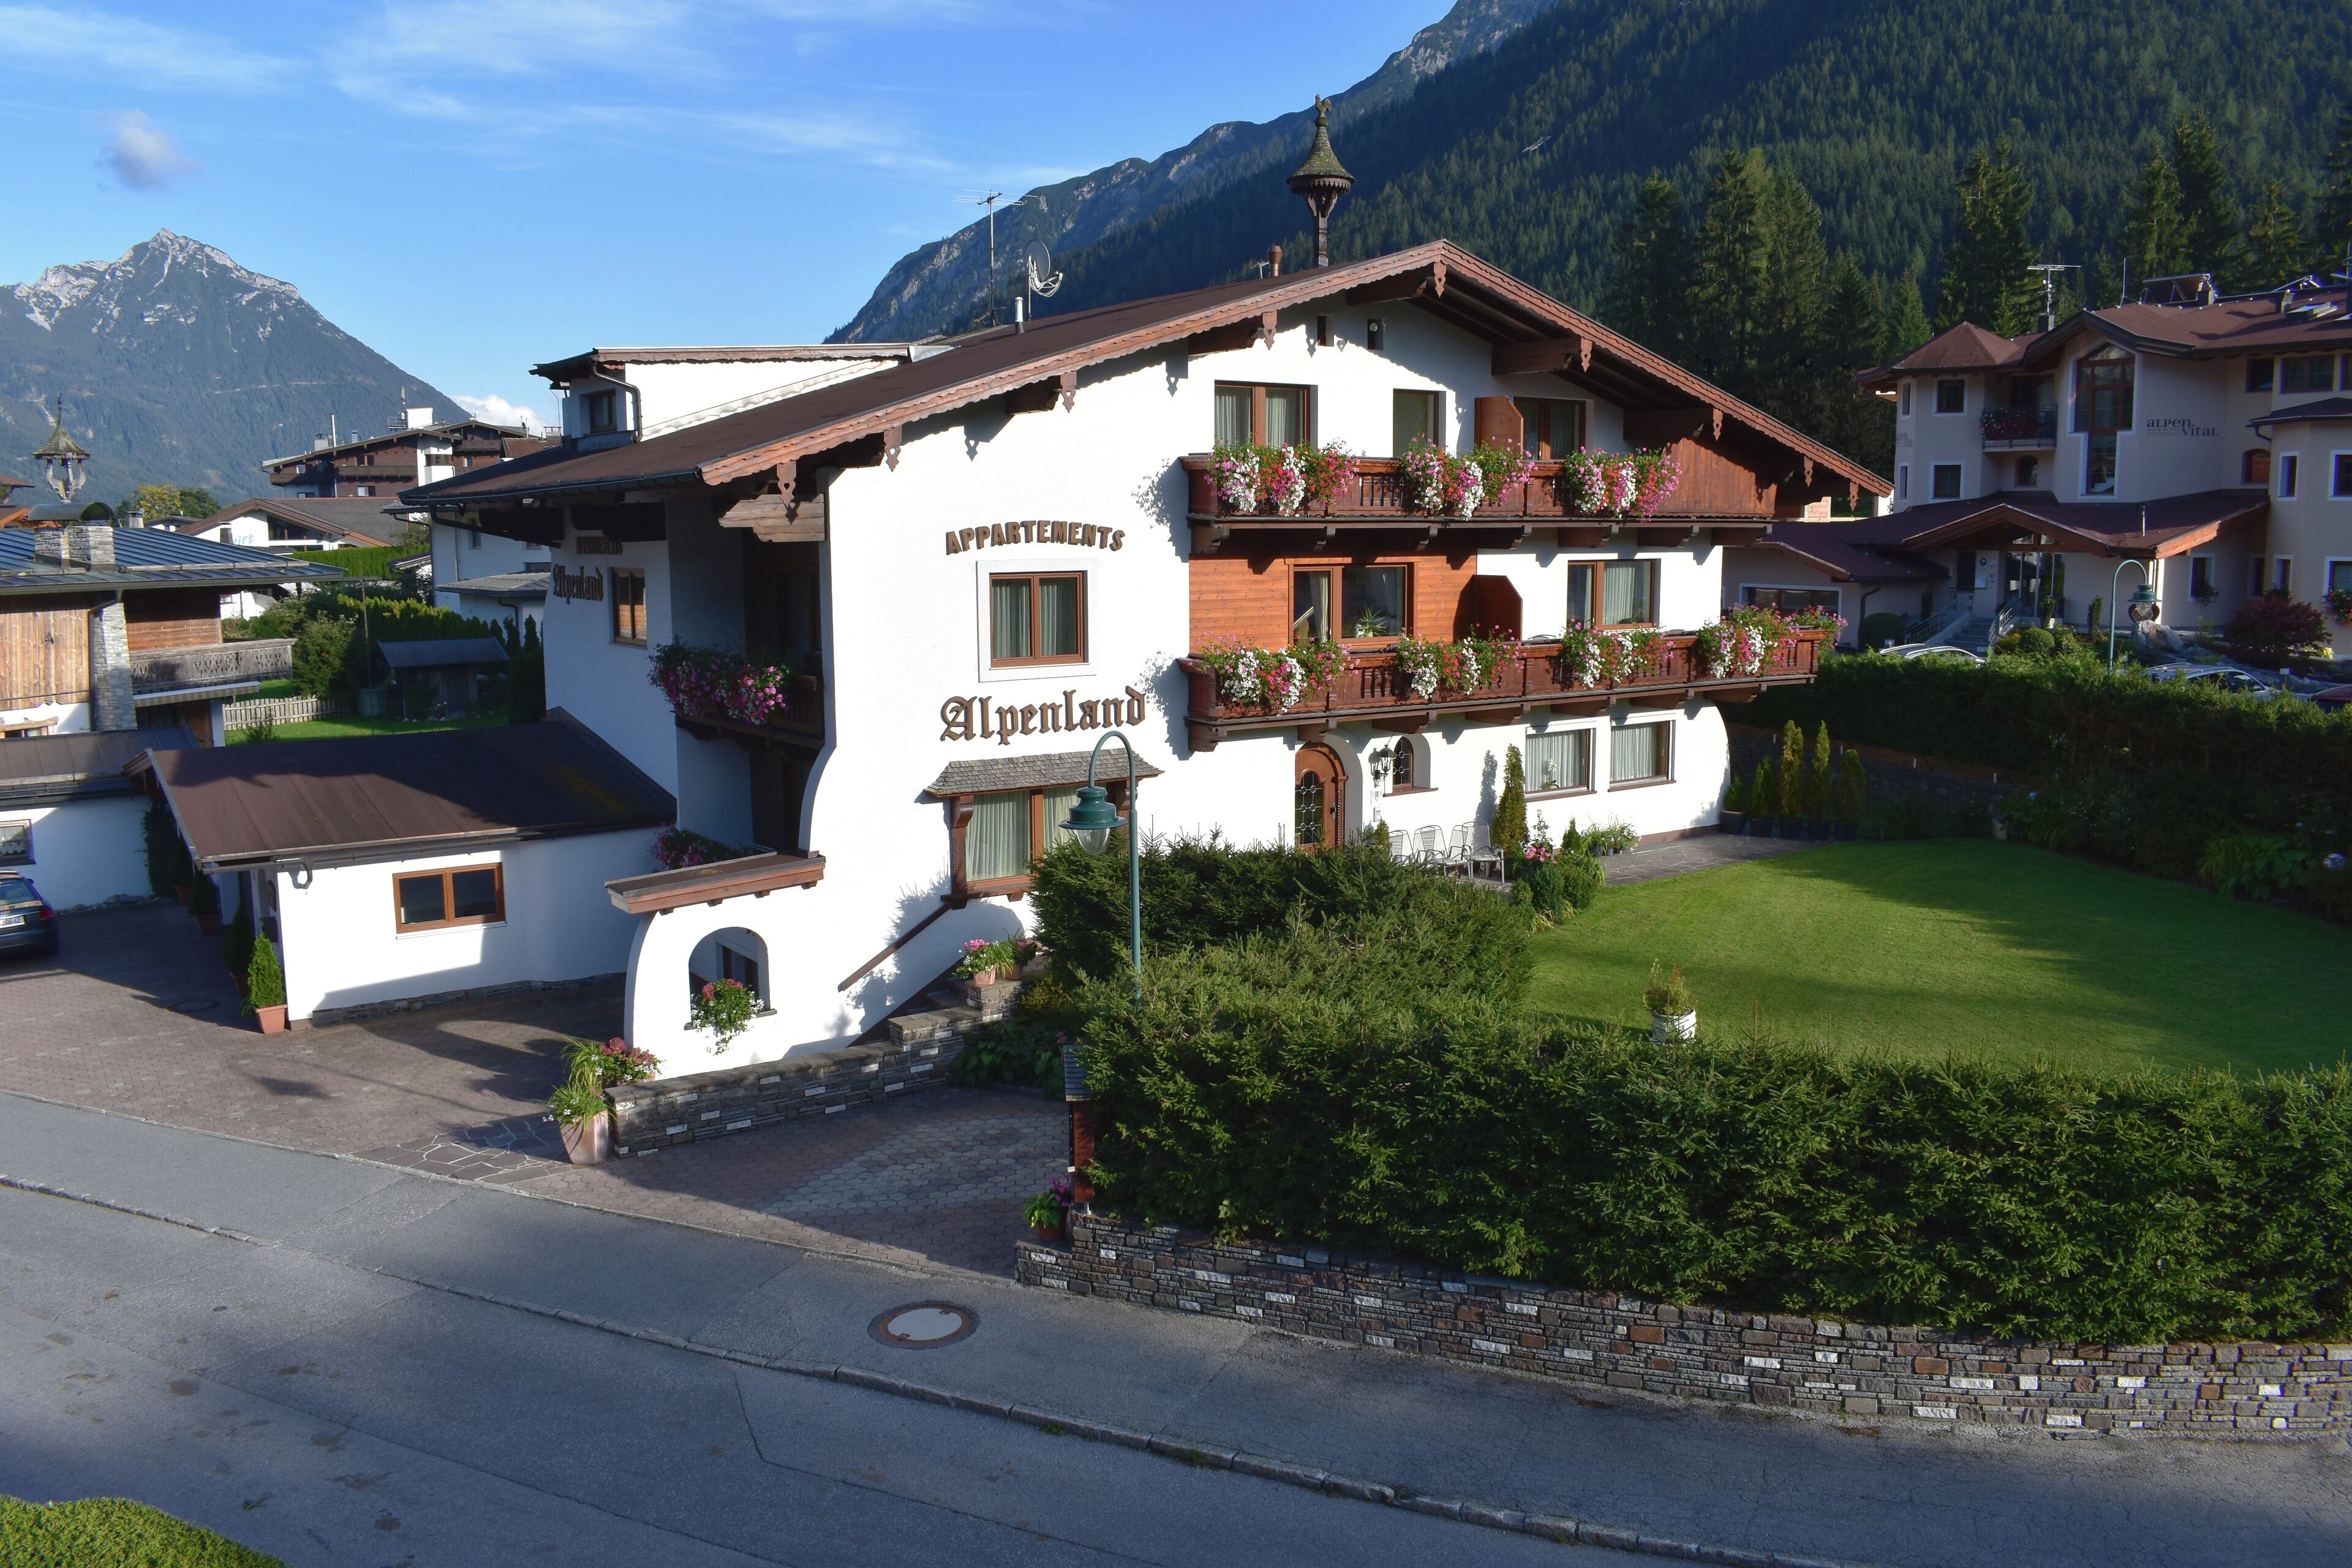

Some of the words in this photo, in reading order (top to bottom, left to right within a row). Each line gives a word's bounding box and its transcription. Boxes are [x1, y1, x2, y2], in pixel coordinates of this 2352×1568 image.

[946, 520, 1126, 556] APPARTEMENTS
[553, 564, 604, 605] Alpenland
[940, 685, 1146, 745] Alpenland
